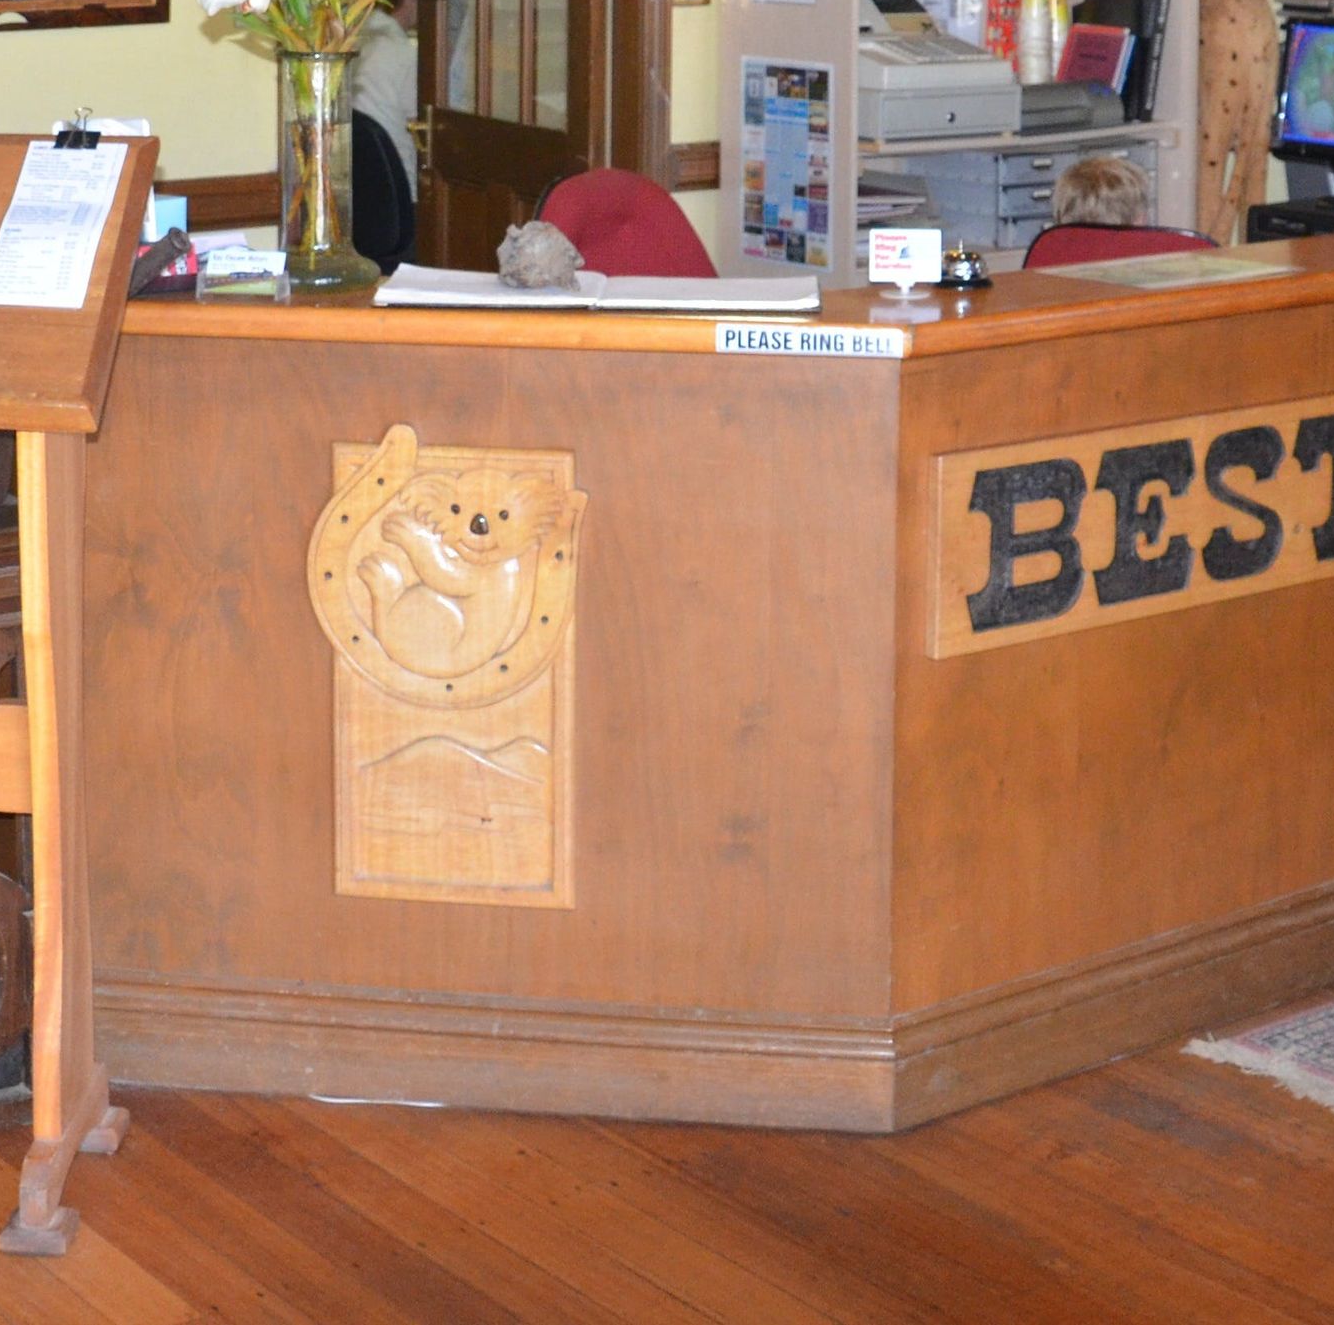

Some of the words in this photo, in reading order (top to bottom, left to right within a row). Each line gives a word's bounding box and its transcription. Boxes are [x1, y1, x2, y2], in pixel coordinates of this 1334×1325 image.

[725, 329, 793, 351] PLEASE
[800, 331, 844, 353] RING
[852, 336, 894, 355] BELL
